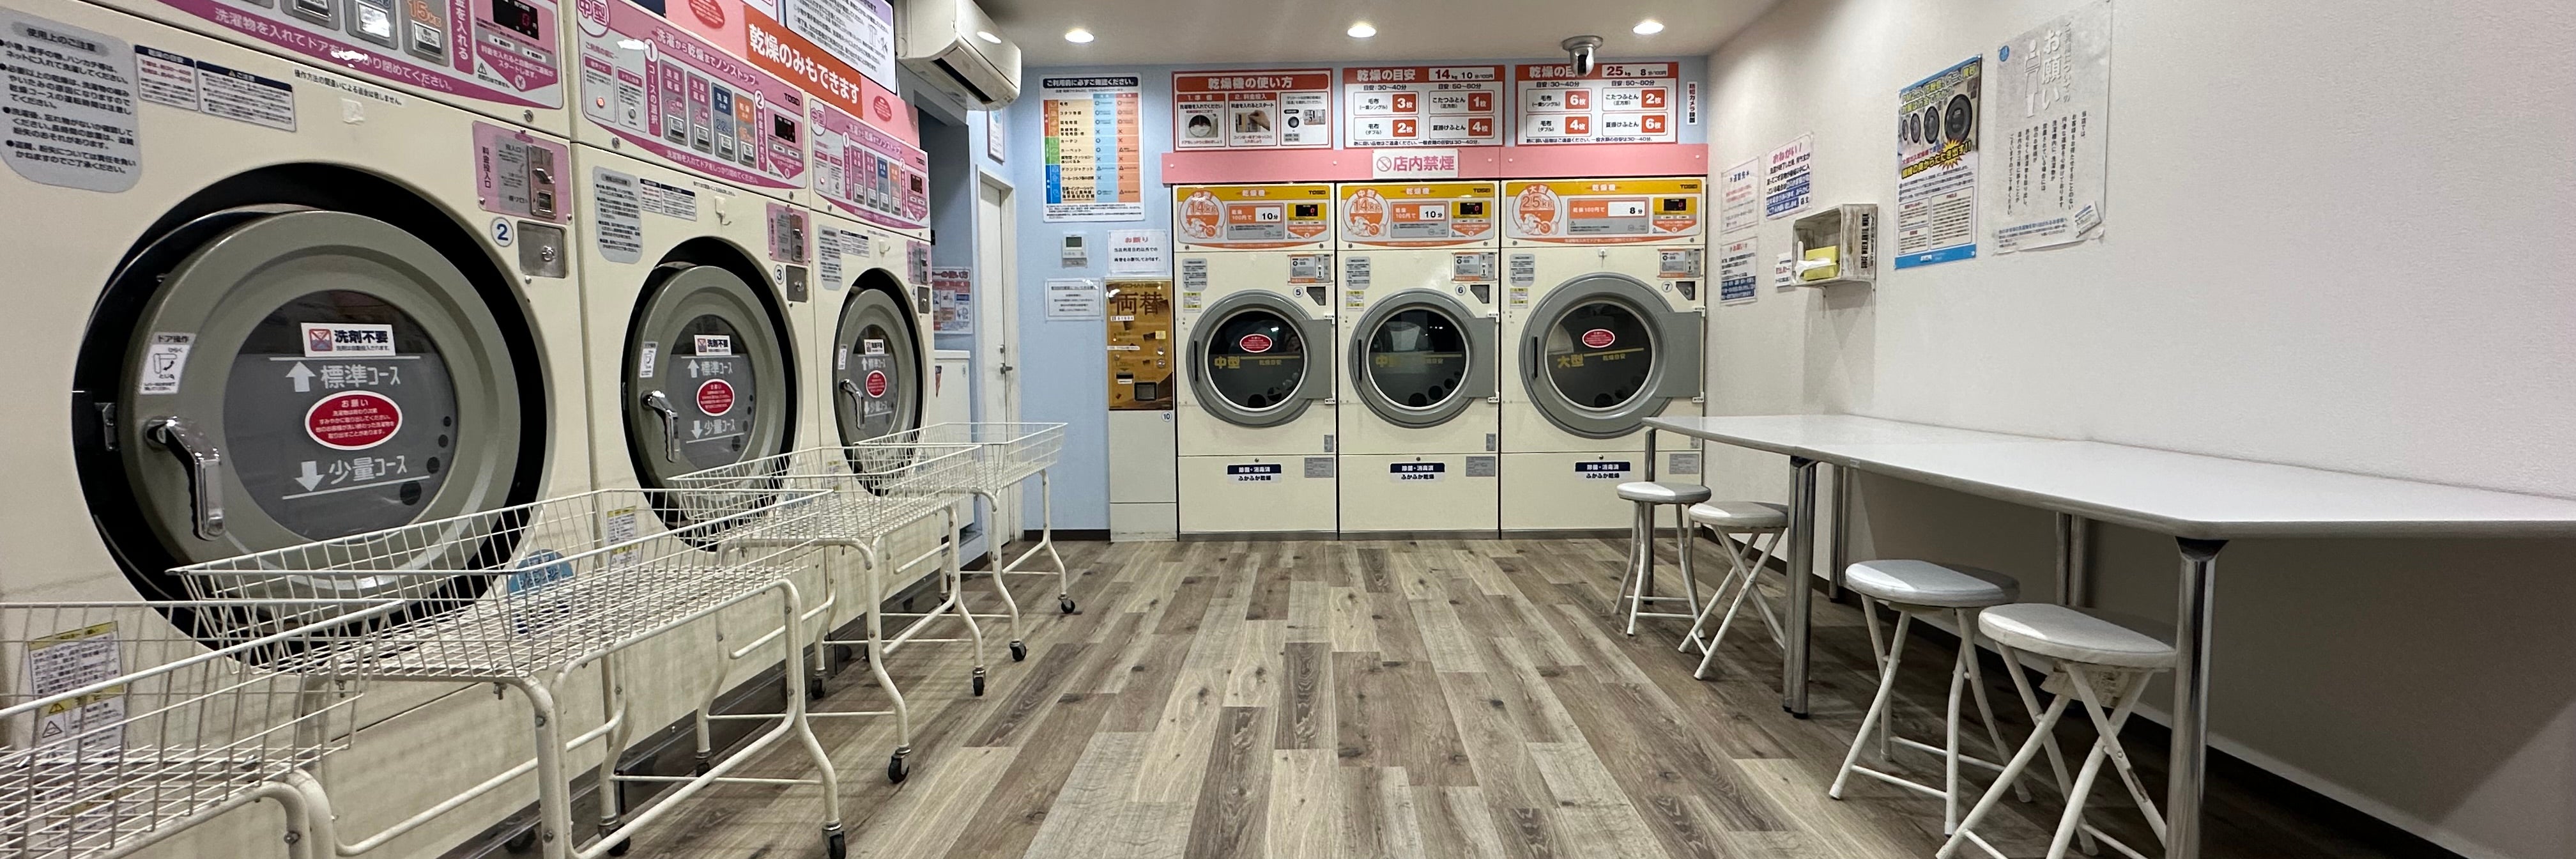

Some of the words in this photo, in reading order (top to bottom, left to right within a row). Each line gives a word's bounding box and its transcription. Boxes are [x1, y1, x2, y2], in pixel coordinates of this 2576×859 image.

[26, 27, 96, 52] 使用上のご注意
[748, 23, 860, 104] 乾燥のみもできます
[1356, 69, 1416, 82] 乾燥の目安
[1529, 66, 1575, 78] 乾燥の目
[2042, 30, 2062, 111] お願い
[1046, 79, 1135, 88] ご利用前に必ずご確認ください。
[1208, 76, 1293, 90] 乾燥機の使い方
[1397, 98, 1413, 109] 3枚
[1473, 97, 1487, 107] 1枚
[1570, 95, 1586, 105] 6枚
[1646, 93, 1662, 104] 2枚
[1397, 123, 1413, 134] 2枚
[1472, 121, 1488, 132] 4枚
[1570, 119, 1586, 130] 4枚
[1645, 119, 1662, 130] 6枚
[1393, 155, 1455, 172] 店内禁煙
[1262, 212, 1278, 221] 10分
[496, 224, 509, 241] 2
[776, 268, 783, 281] 3
[1116, 291, 1165, 316] 両替
[334, 330, 388, 344] 洗剤不要
[1214, 355, 1240, 369] 中型
[1557, 354, 1584, 368] 大型
[701, 361, 733, 376] 標準コース
[321, 364, 401, 389] 標準コース
[341, 399, 369, 408] お願い
[704, 419, 735, 435] 少量コース
[329, 455, 408, 485] 少量コース
